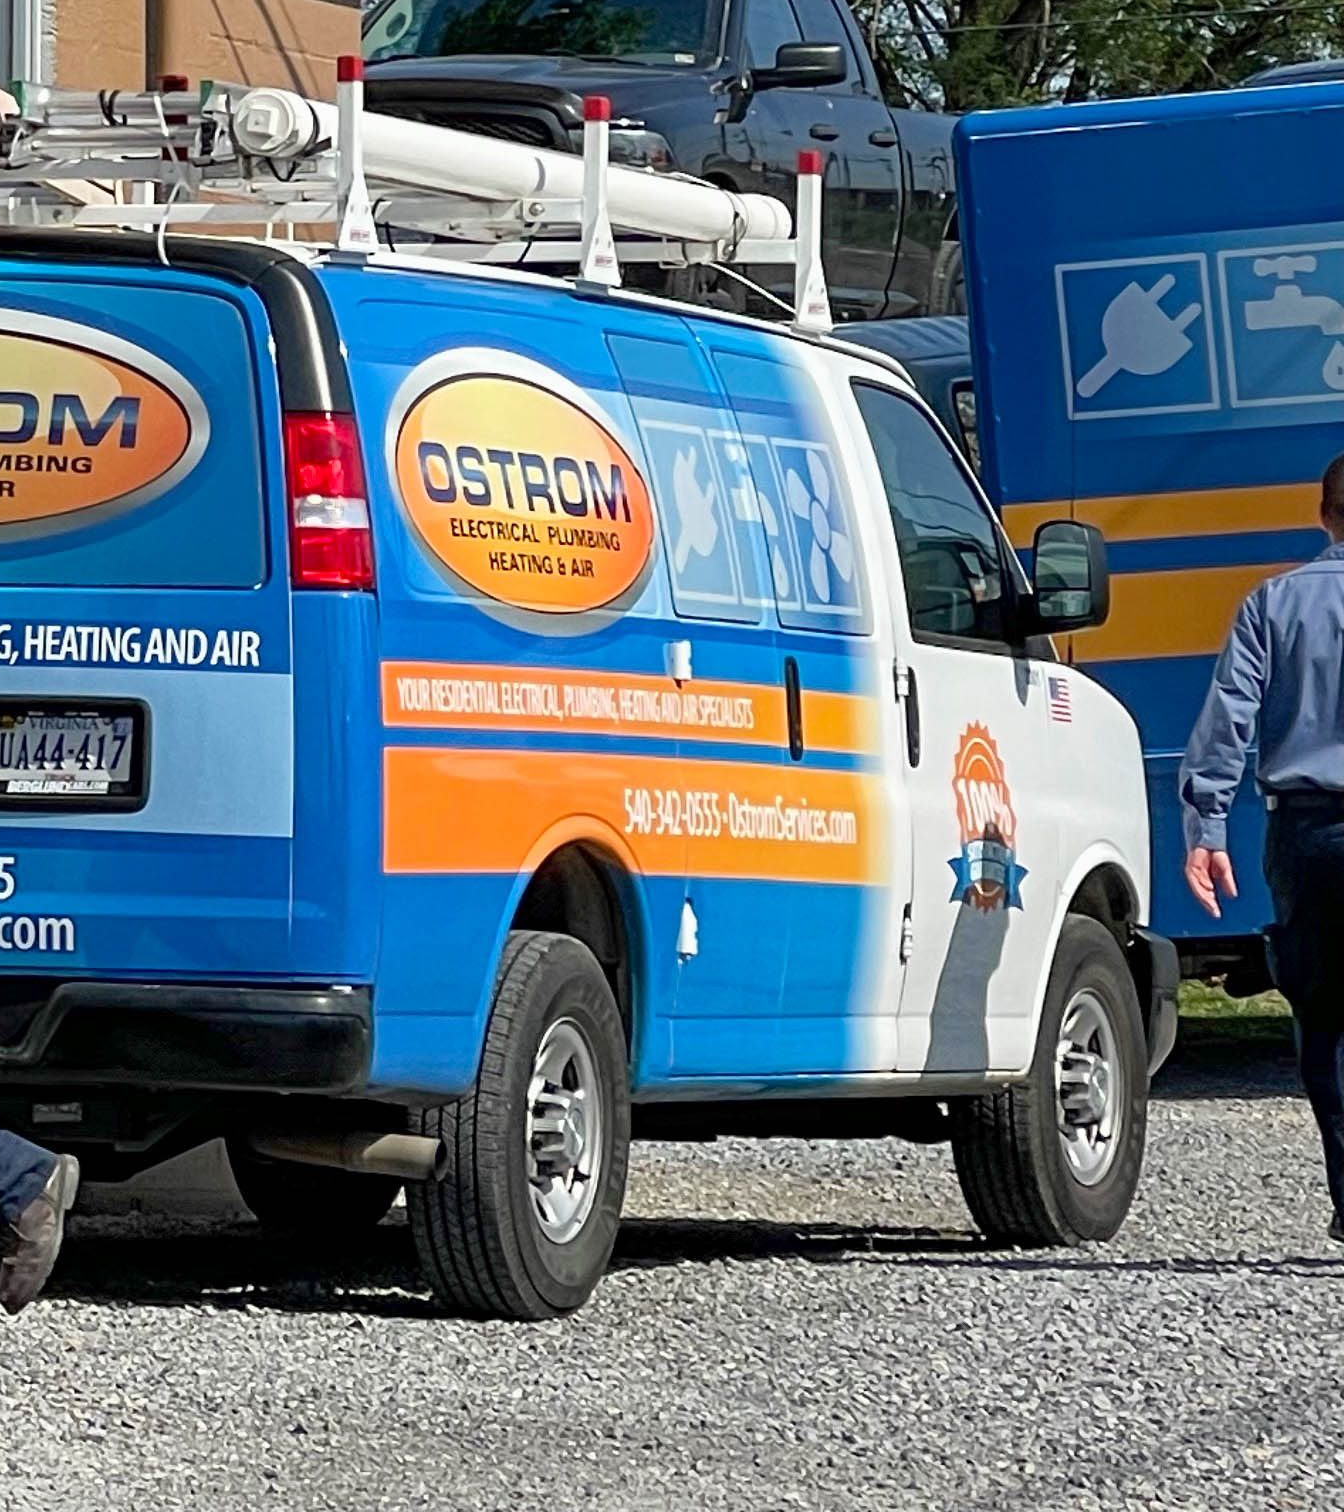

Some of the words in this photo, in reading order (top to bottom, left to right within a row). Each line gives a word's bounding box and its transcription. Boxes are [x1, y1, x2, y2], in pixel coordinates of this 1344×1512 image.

[418, 441, 632, 523] OSTROM
[450, 517, 540, 543] ELECTRICAL
[548, 525, 621, 552] PLUMBING
[488, 551, 553, 575] HEATING
[558, 558, 566, 576] &
[571, 557, 595, 577] AIR
[24, 624, 141, 664] HEATING
[143, 628, 207, 665] AND
[210, 630, 260, 666] AIR
[28, 716, 100, 731] VIRGINIA
[397, 677, 430, 711] YOUR
[431, 679, 500, 714] RESIDENTIAL
[619, 688, 661, 723] HEATING
[661, 692, 682, 724] AND
[682, 694, 699, 725] AIR
[699, 695, 754, 729] SPECIALISTS
[624, 788, 722, 837] 540-342-0555
[728, 792, 857, 844] OstromServices.com
